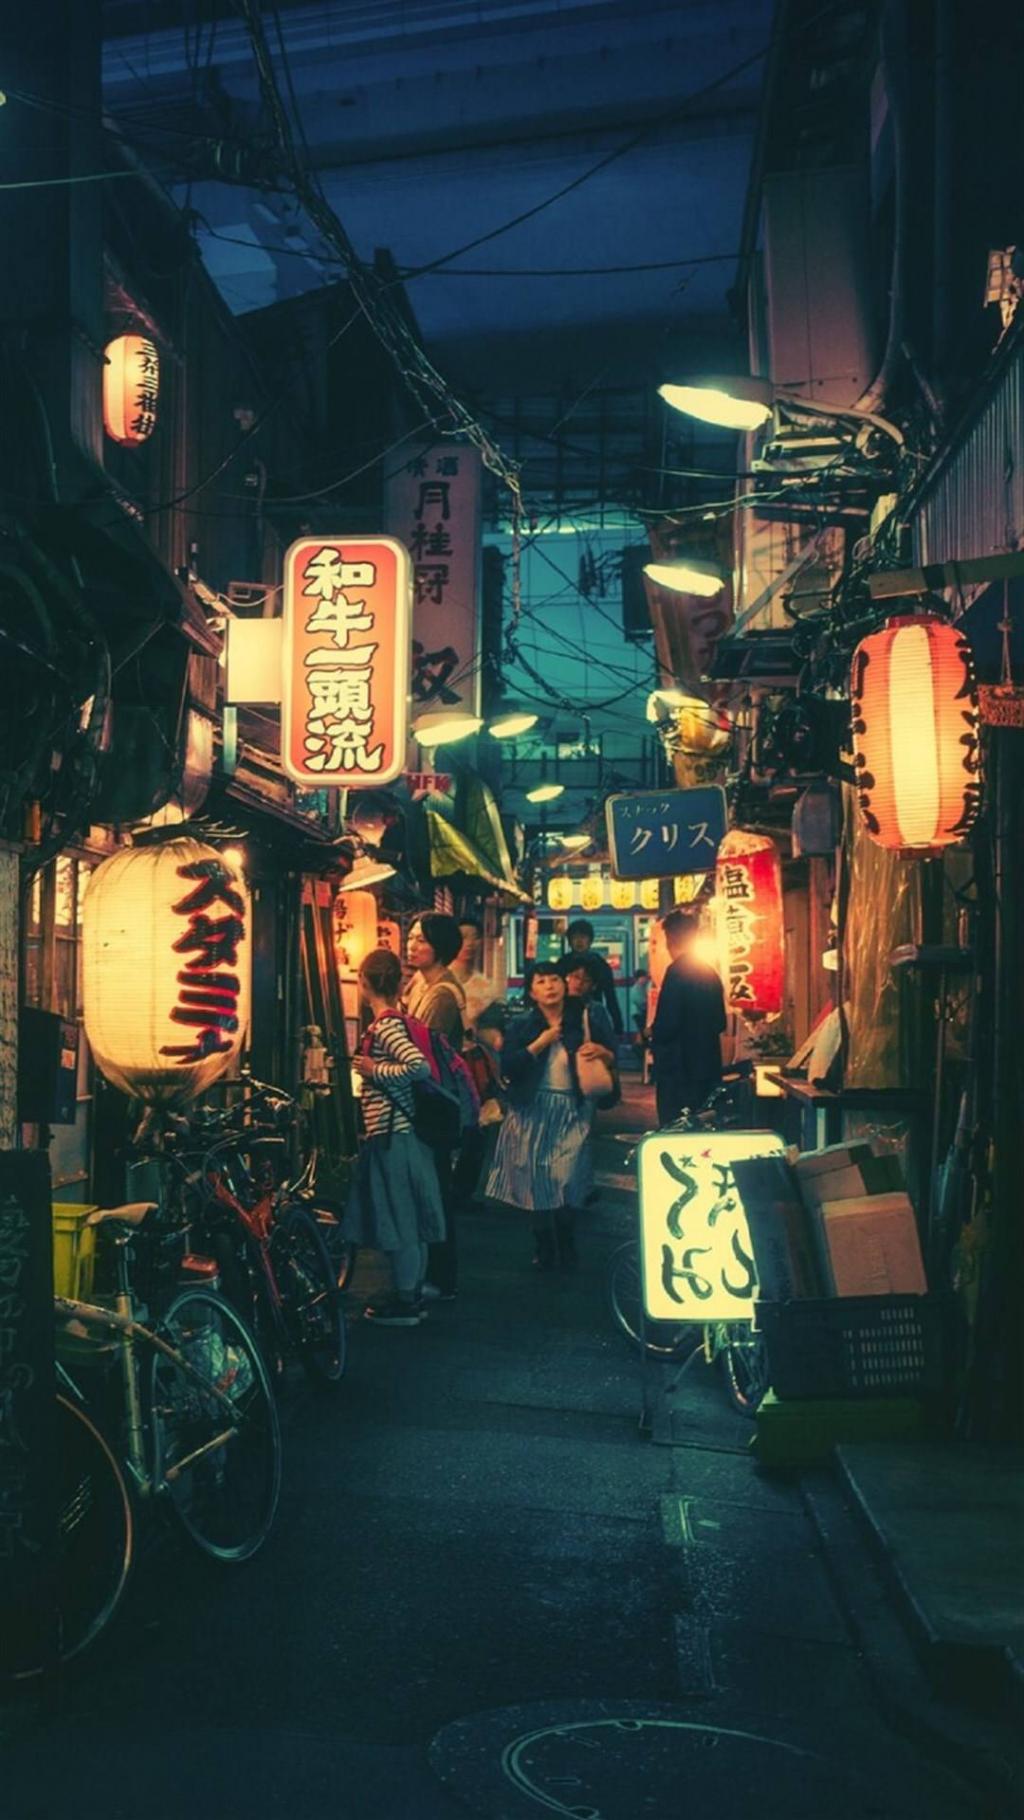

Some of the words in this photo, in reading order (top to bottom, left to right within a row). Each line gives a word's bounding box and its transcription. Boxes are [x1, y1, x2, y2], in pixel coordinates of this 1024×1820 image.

[410, 480, 454, 605] 月桂冠
[303, 546, 385, 773] 和牛一頭流
[630, 822, 715, 856] クリス
[158, 859, 246, 1065] スタミナ
